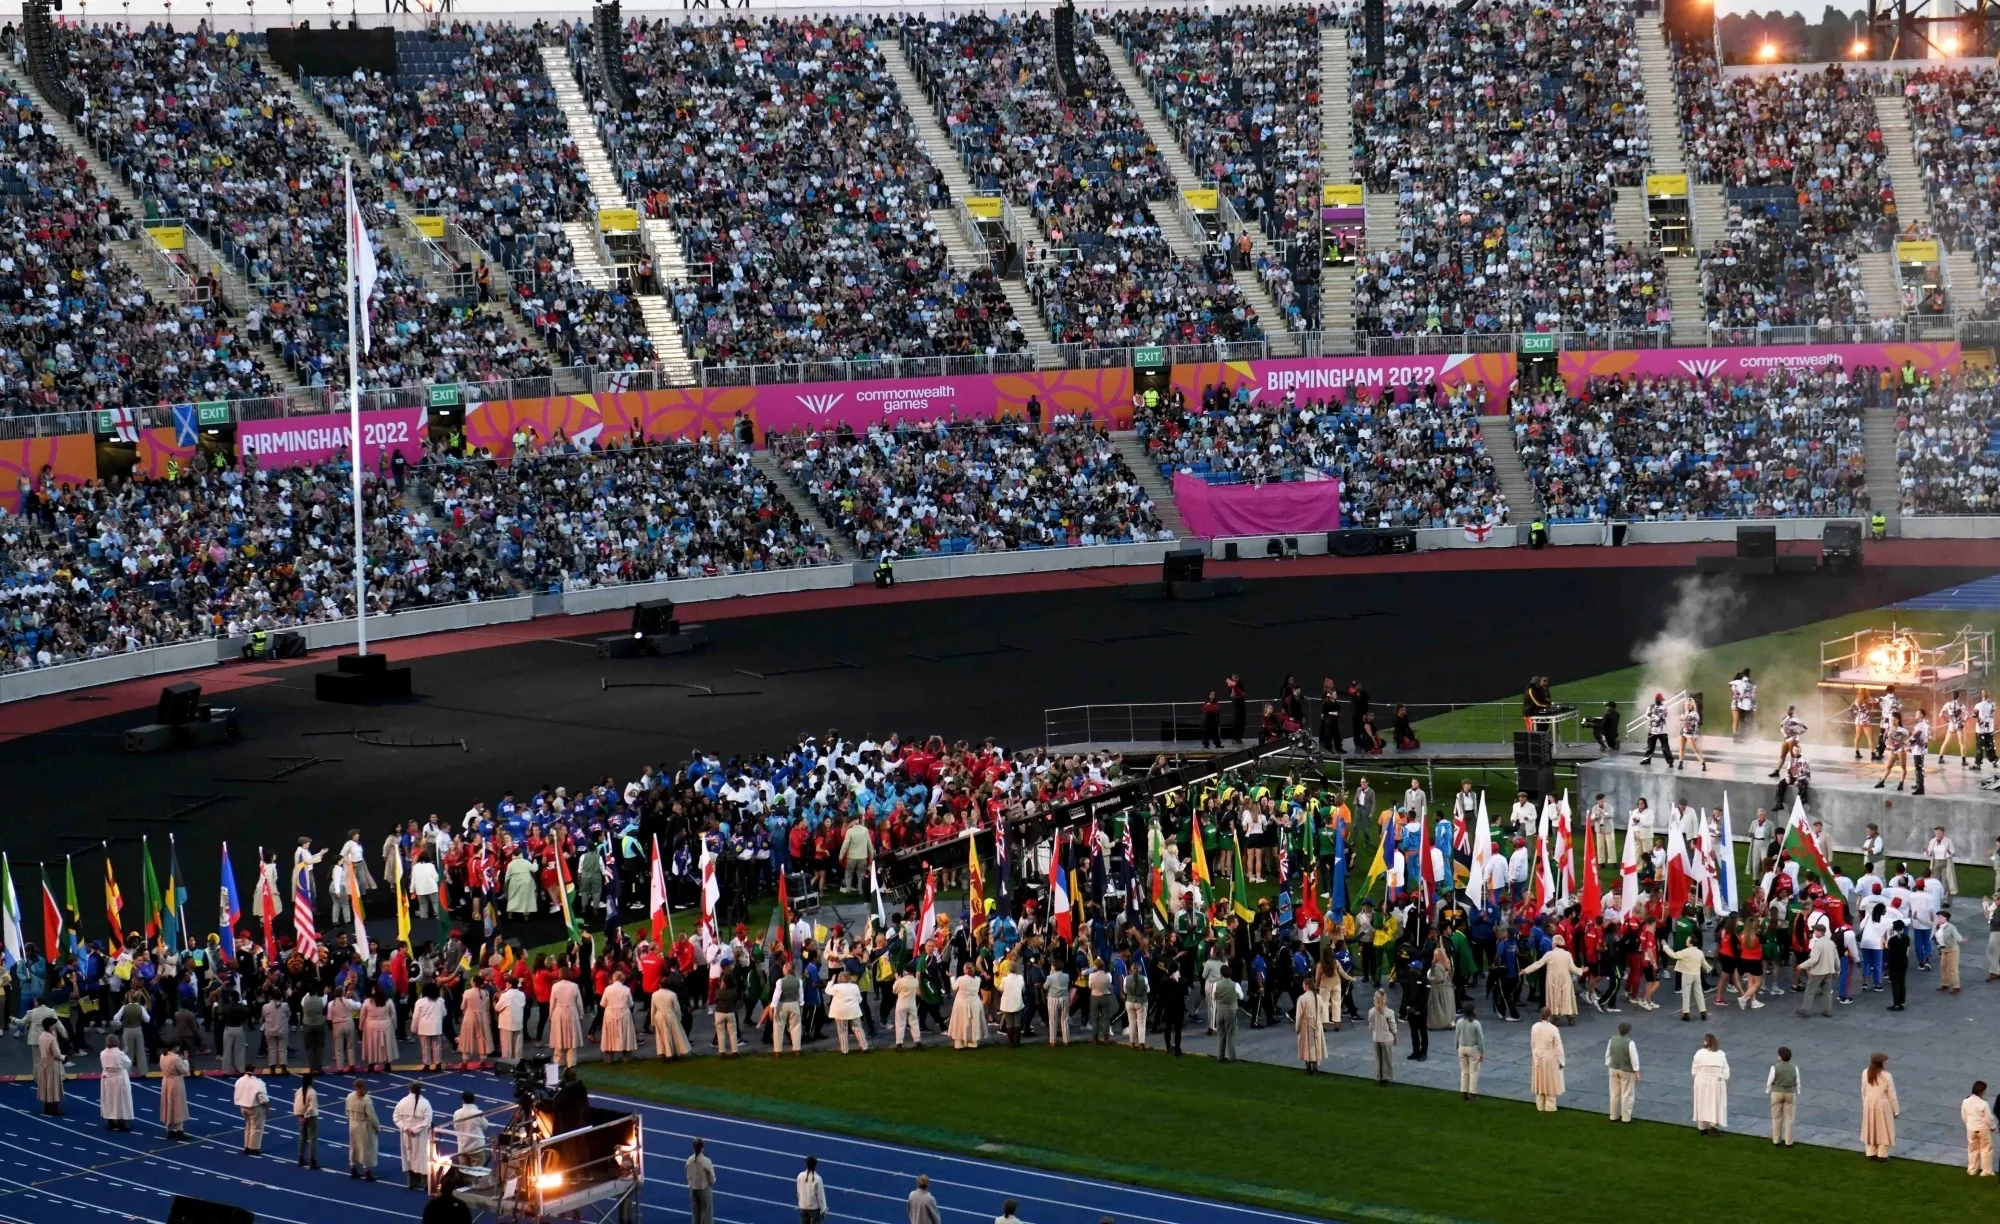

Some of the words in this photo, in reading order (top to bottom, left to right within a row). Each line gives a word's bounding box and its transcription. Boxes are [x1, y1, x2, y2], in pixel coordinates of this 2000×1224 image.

[1525, 338, 1551, 348] EXIT
[1136, 351, 1161, 362] EXIT
[1740, 353, 1842, 367] commonwealth
[1267, 368, 1384, 391] BIRMINGHAM
[1388, 366, 1435, 387] 2022
[432, 389, 456, 401] EXIT
[856, 385, 955, 401] commonwealth
[884, 399, 928, 413] games
[201, 407, 226, 420] EXIT
[364, 421, 409, 445] 2022
